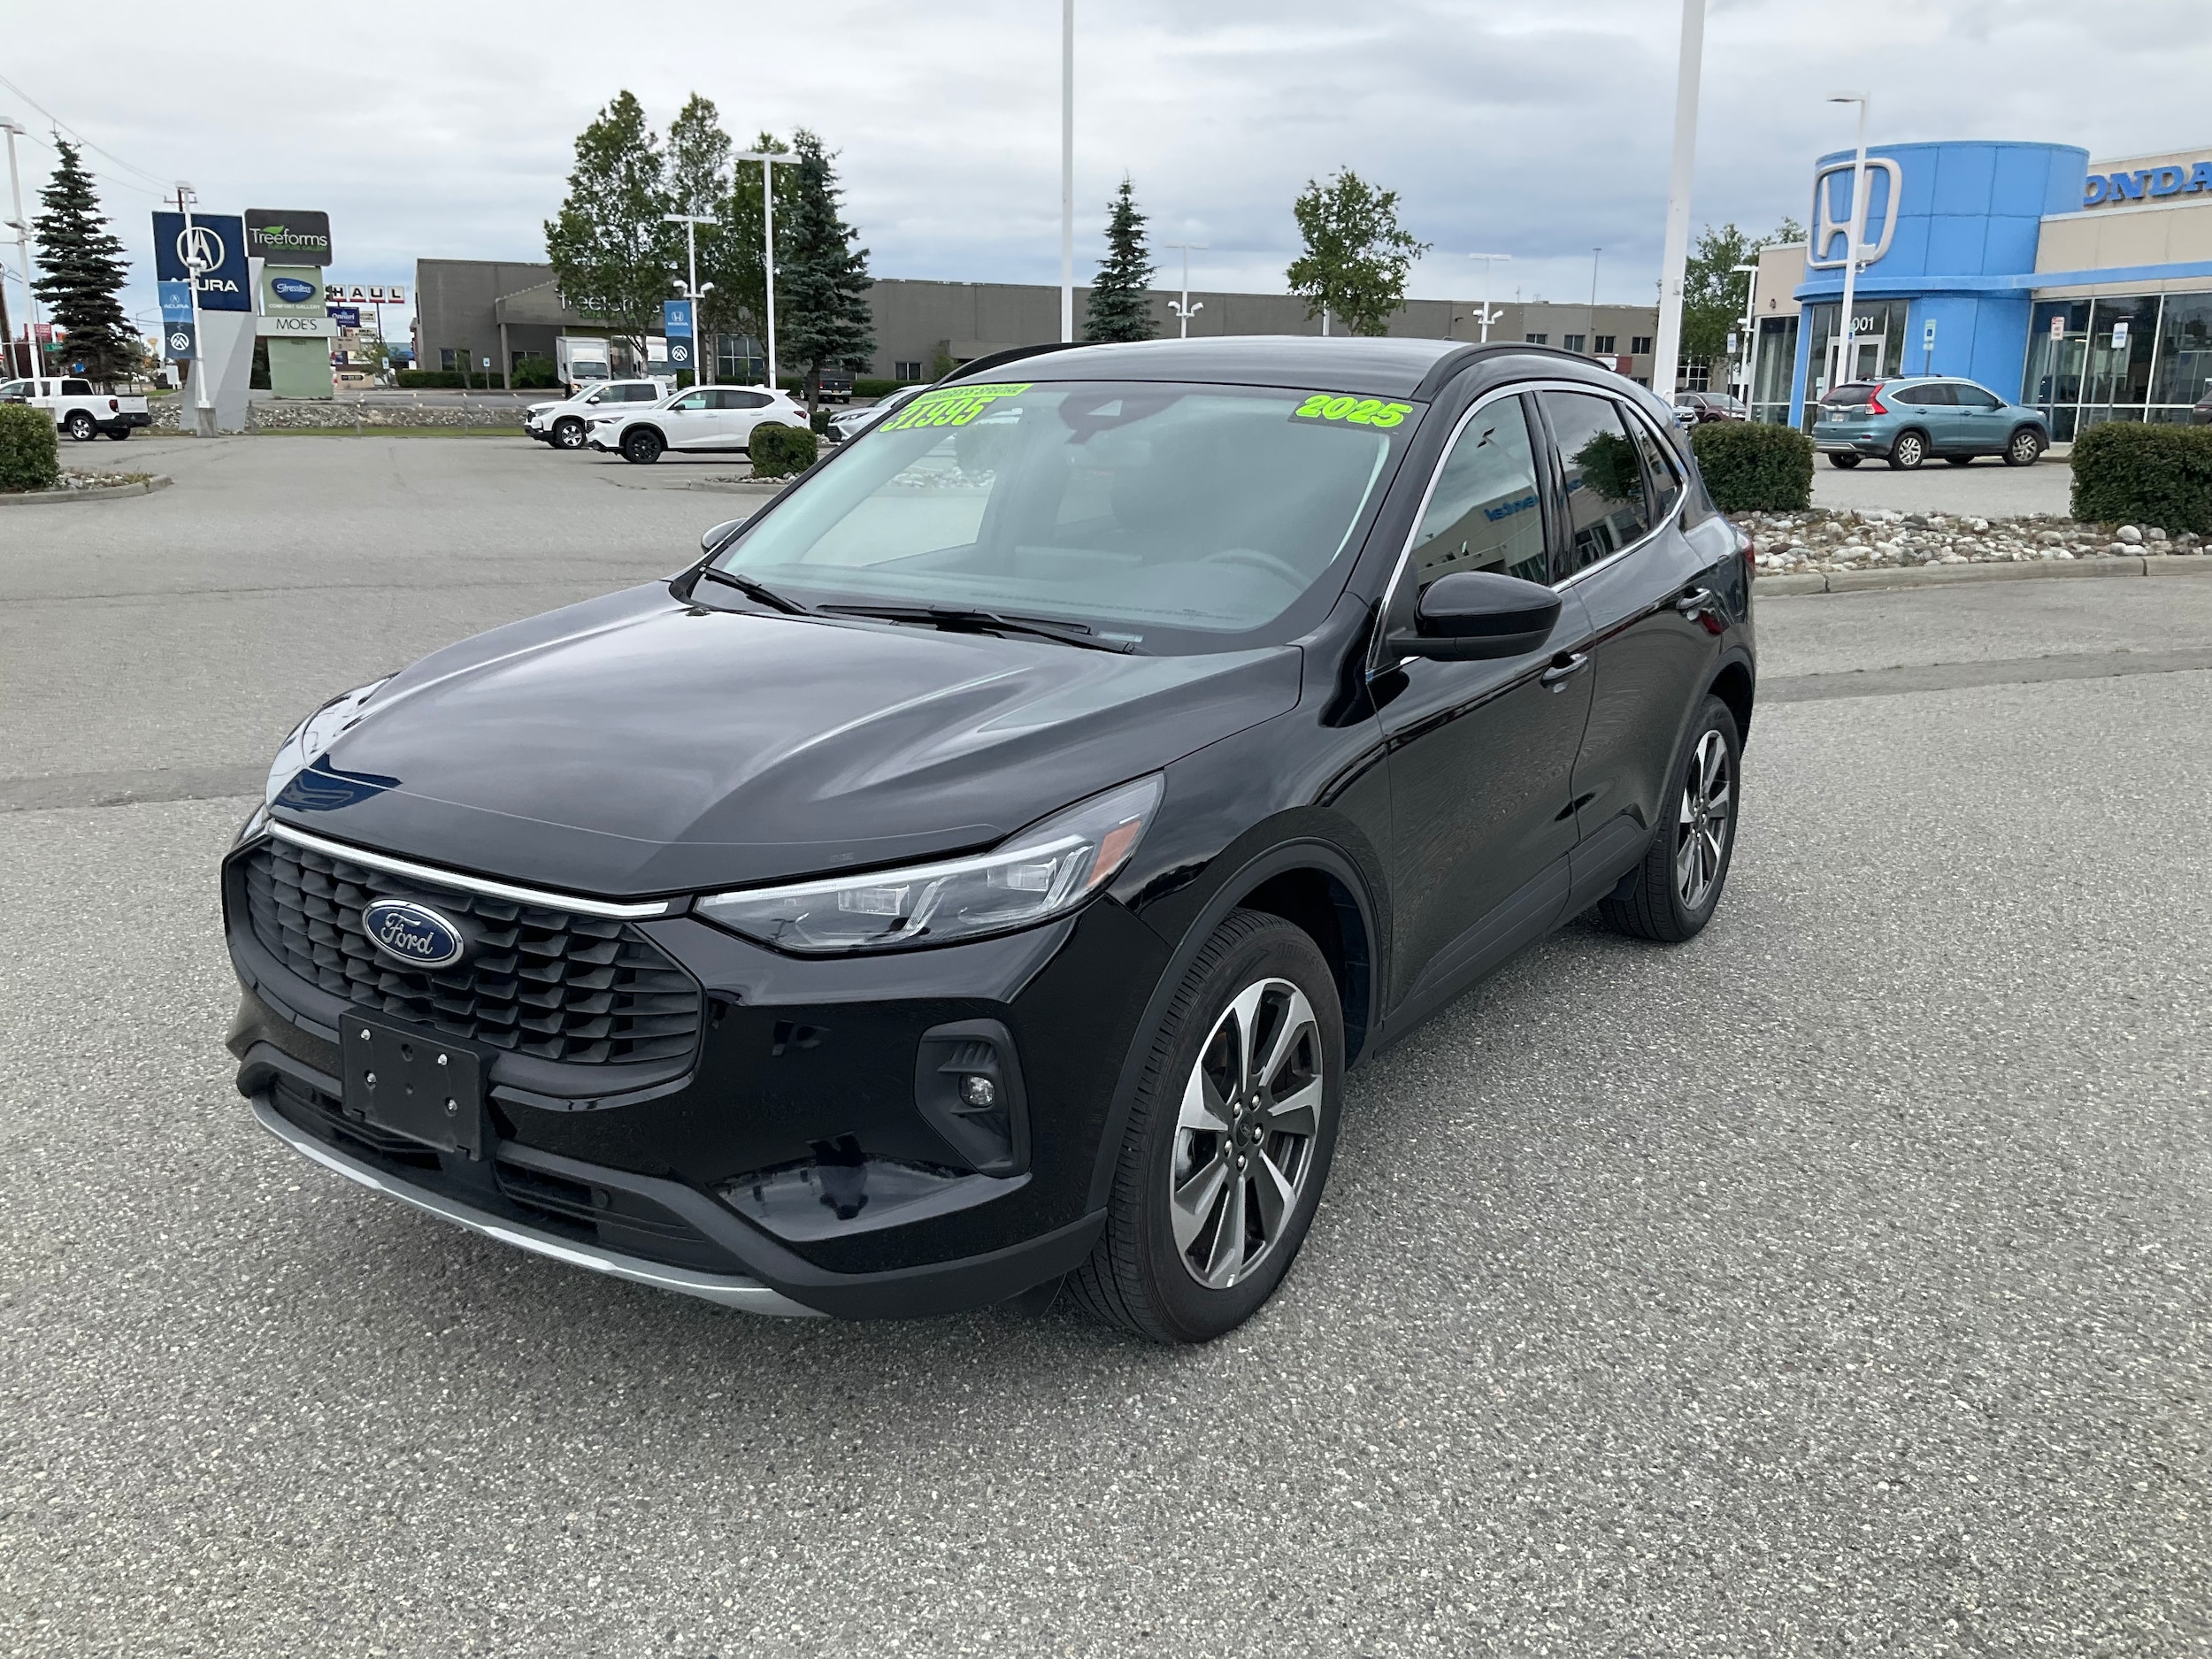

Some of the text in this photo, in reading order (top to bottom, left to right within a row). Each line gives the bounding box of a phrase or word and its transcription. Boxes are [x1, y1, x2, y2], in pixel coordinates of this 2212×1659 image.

[249, 227, 327, 247] Treeforms
[171, 277, 239, 292] URA
[277, 283, 311, 294] Stressless
[276, 319, 317, 330] MOE'S
[879, 397, 998, 433] 31995
[1295, 395, 1414, 428] 2025
[380, 912, 434, 955] Ford
